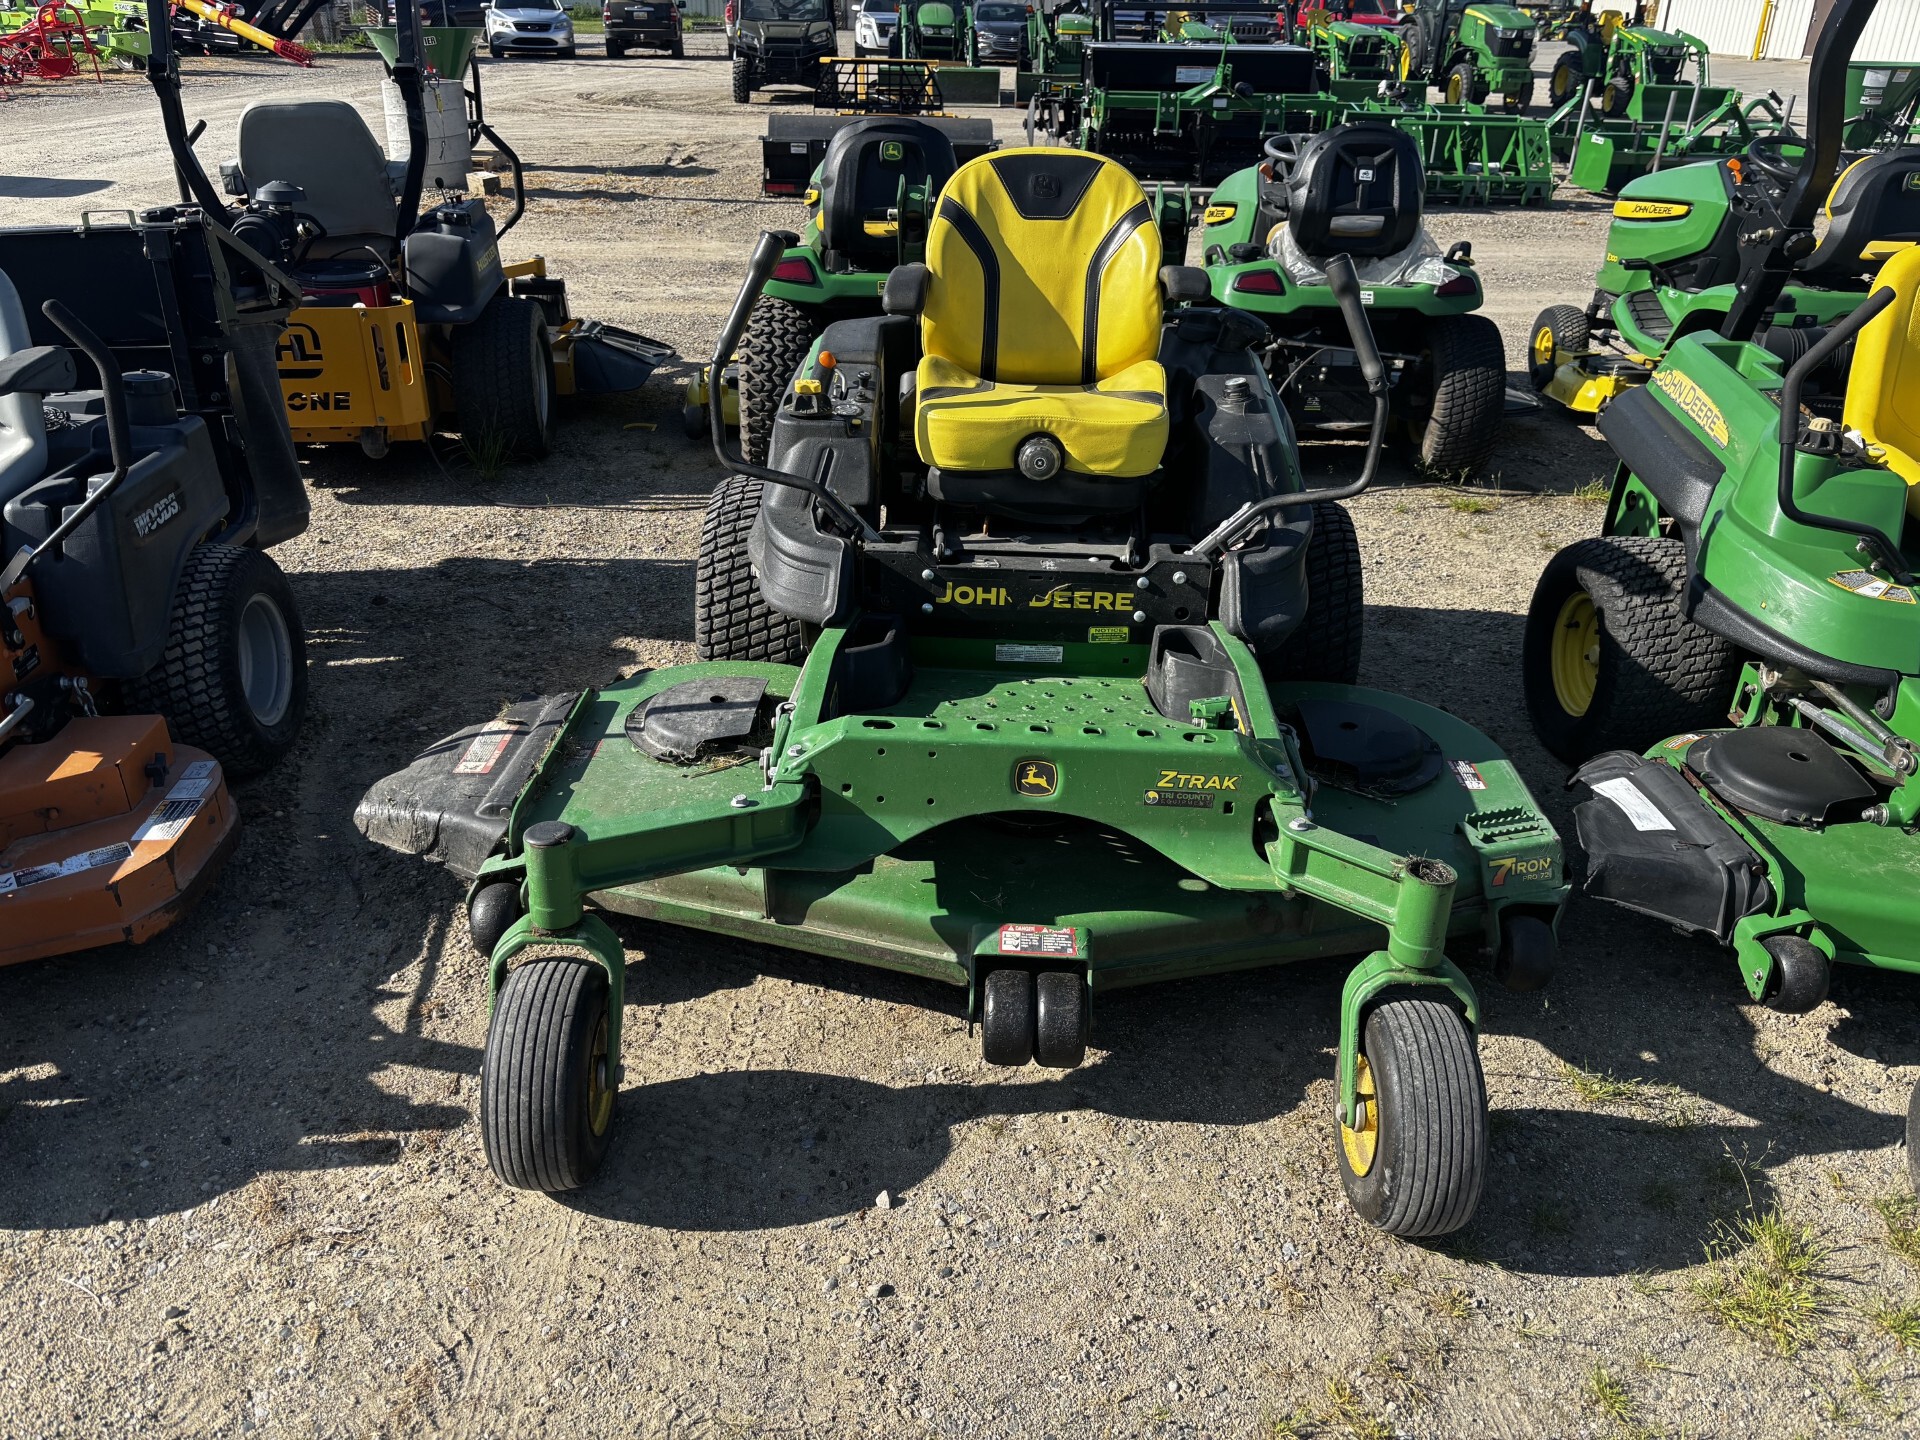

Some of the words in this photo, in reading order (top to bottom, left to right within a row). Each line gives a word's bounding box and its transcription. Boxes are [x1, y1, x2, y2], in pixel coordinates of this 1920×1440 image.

[1632, 204, 1649, 213] JOHN
[1649, 204, 1673, 214] DEERE
[1659, 371, 1686, 399] JOHN
[1683, 385, 1720, 433] DEERE
[133, 492, 181, 538] WOODS
[1156, 770, 1240, 790] ZTRAK
